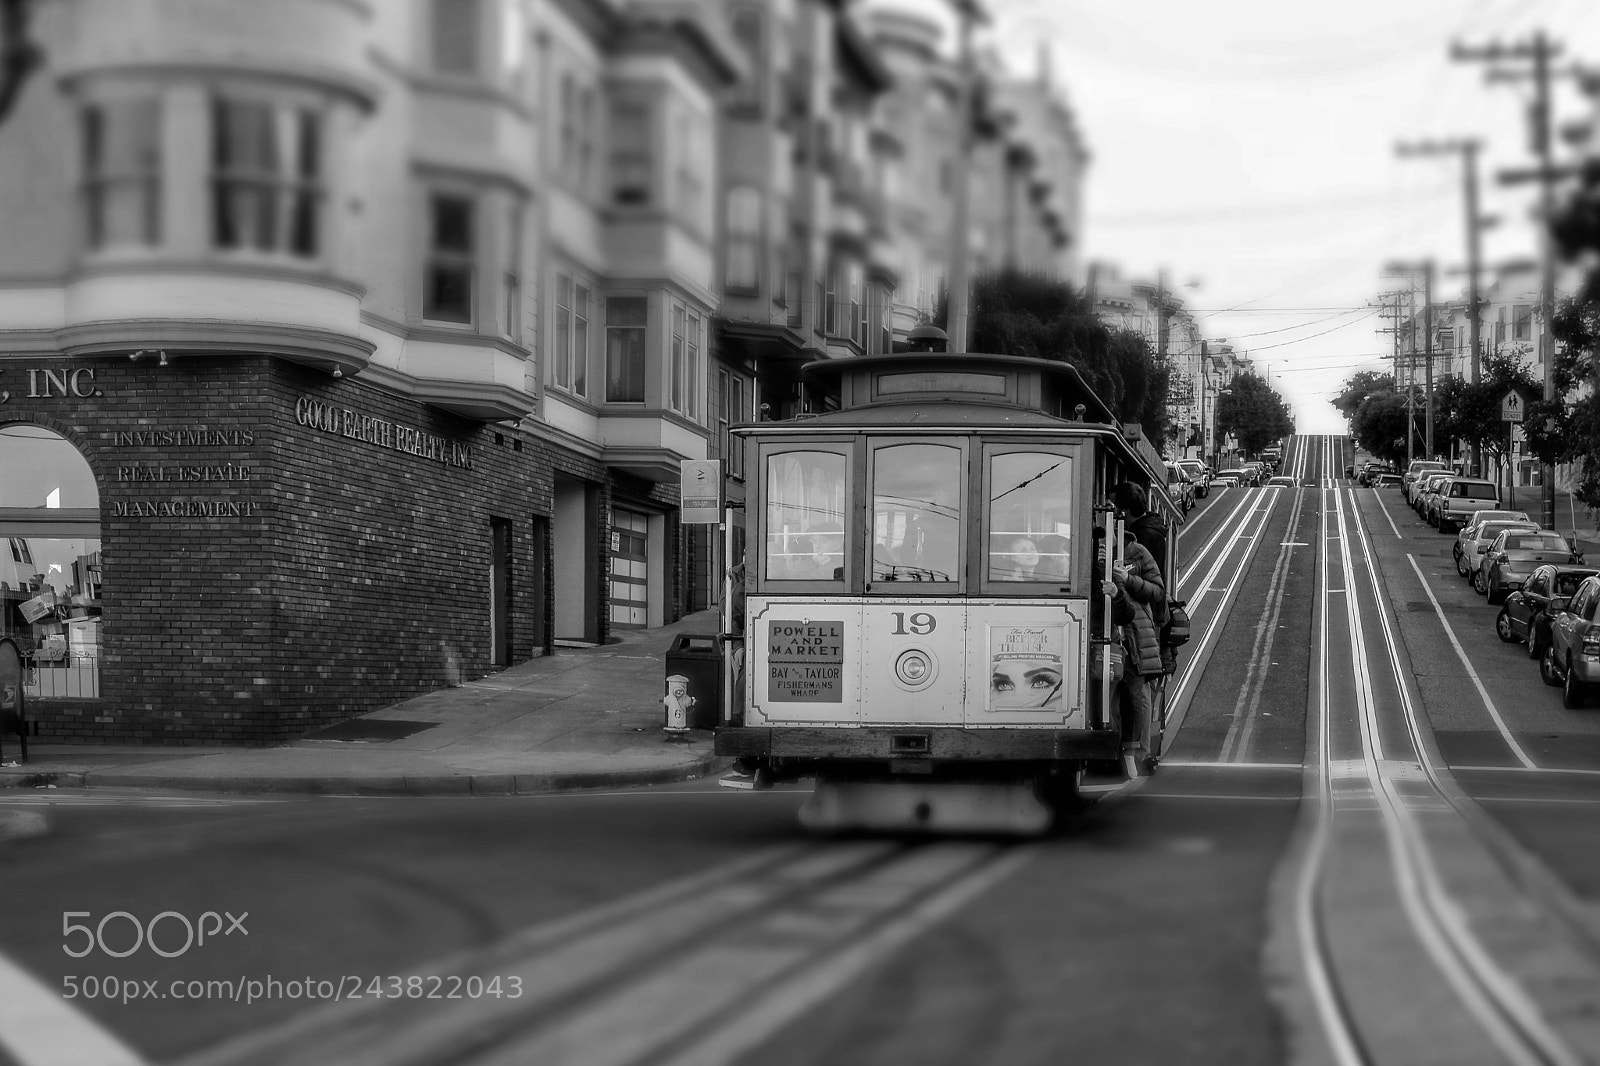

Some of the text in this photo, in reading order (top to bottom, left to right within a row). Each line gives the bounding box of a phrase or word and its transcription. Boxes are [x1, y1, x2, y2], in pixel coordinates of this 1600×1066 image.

[26, 368, 103, 398] INC.
[296, 396, 338, 433] GOOD
[343, 409, 393, 448] EARTH
[113, 430, 254, 447] INVESTMENTS
[117, 465, 250, 482] REAL ESTATE
[112, 500, 256, 517] MANAGEMENT
[891, 612, 937, 635] 19
[773, 626, 840, 637] POWELL
[790, 637, 823, 645] AND
[771, 646, 840, 656] MARKET
[771, 667, 788, 679] BAY
[805, 667, 840, 679] TAYLOR
[777, 681, 833, 689] FISHERMANS
[790, 689, 820, 697] WHARF
